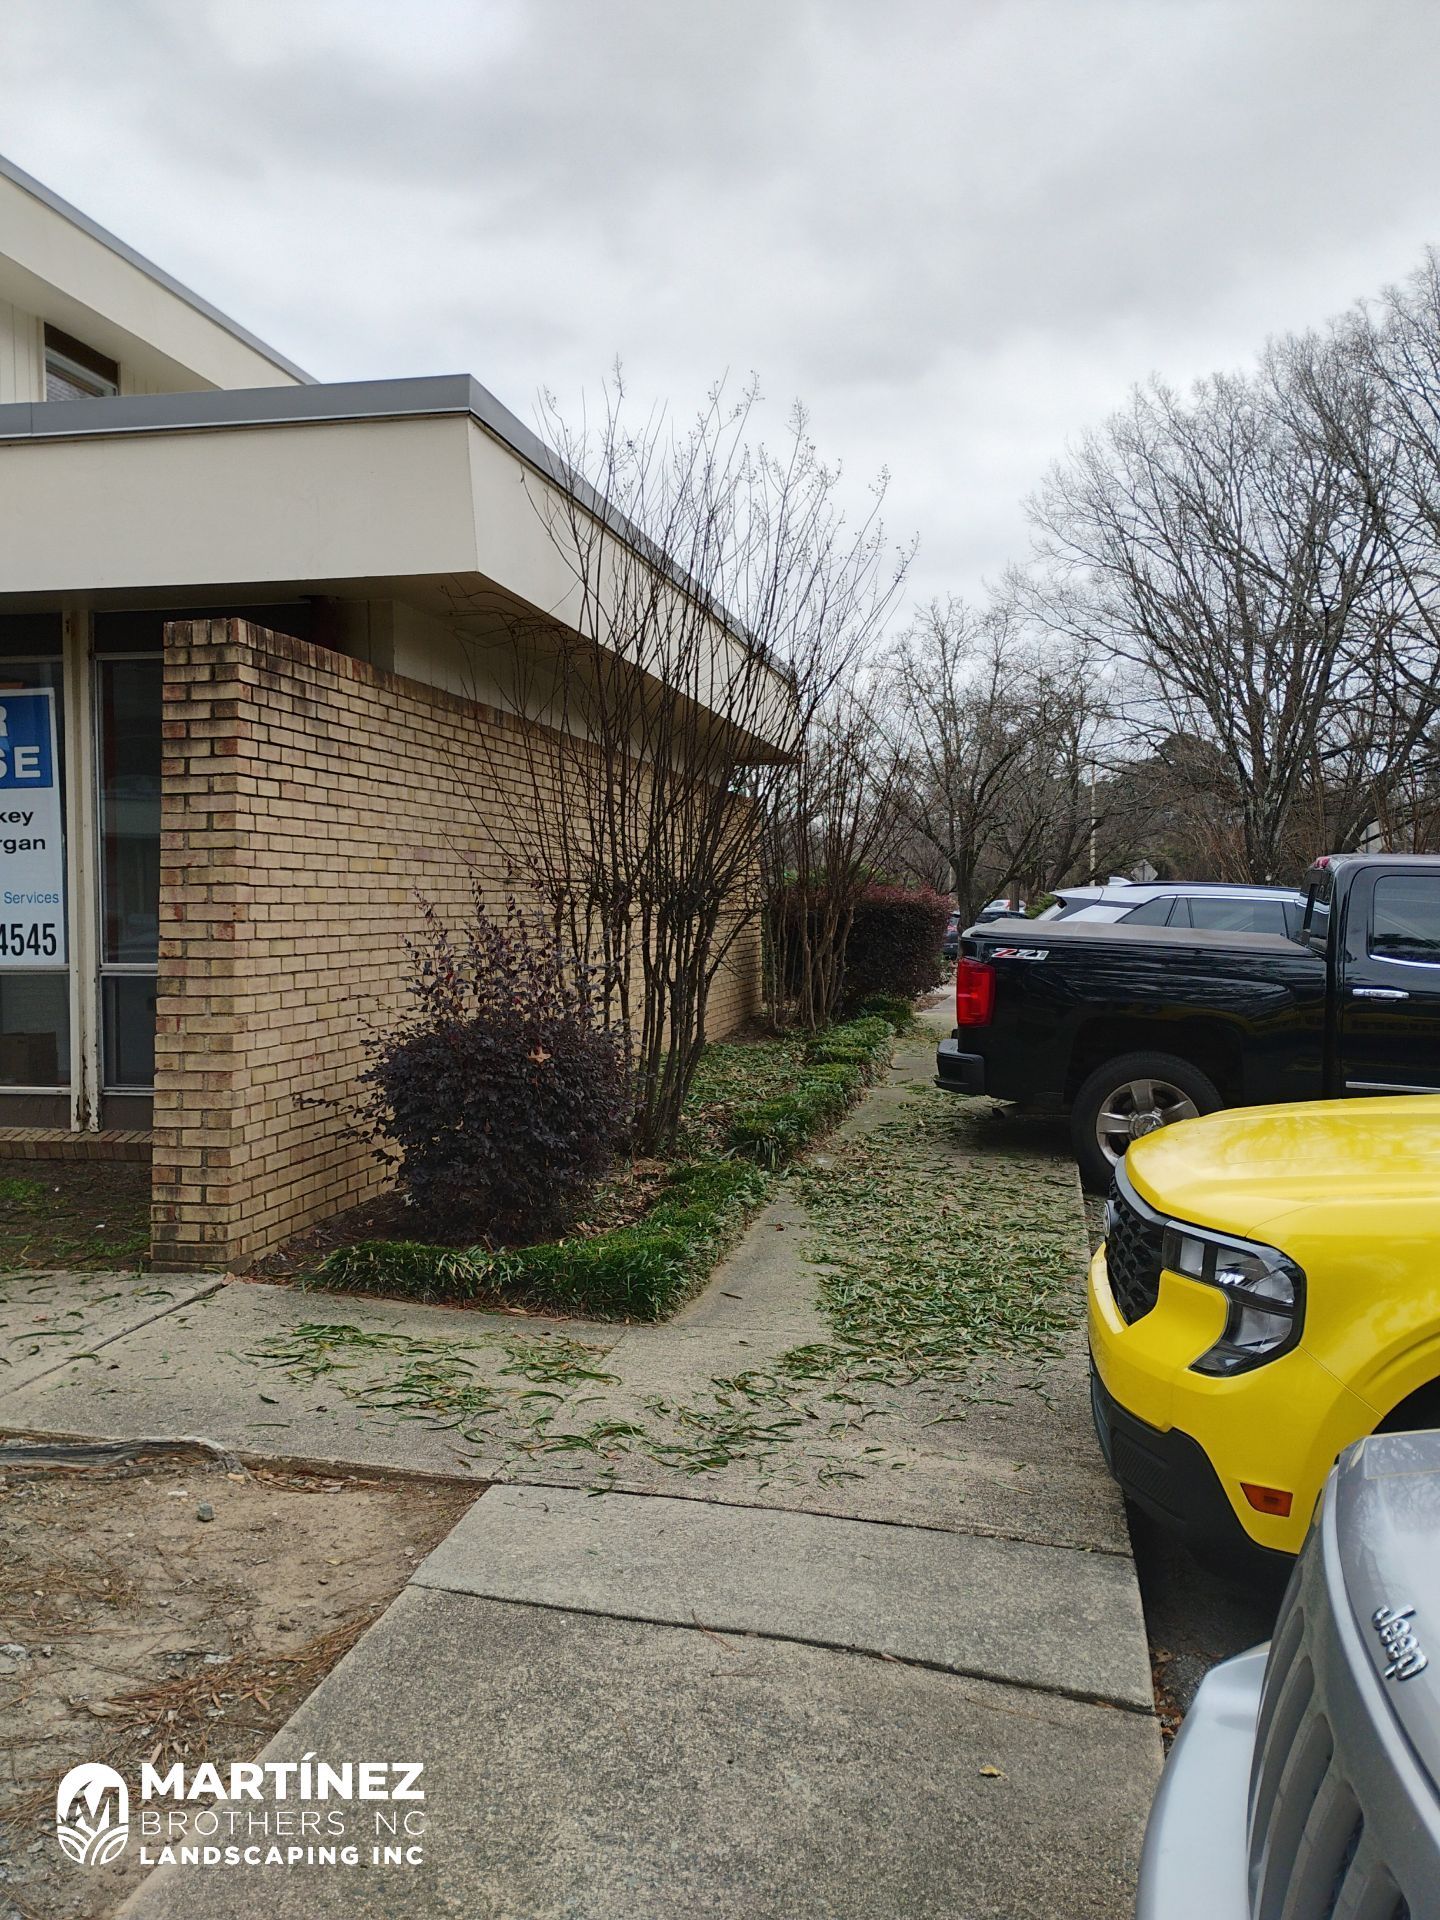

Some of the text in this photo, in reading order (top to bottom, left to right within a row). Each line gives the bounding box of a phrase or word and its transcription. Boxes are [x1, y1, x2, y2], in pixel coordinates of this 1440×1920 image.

[0, 746, 41, 779] E
[0, 838, 46, 854] gan
[4, 891, 59, 904] Services
[0, 923, 57, 956] 4545
[991, 947, 1050, 961] Z71
[1371, 1604, 1428, 1681] Jeep
